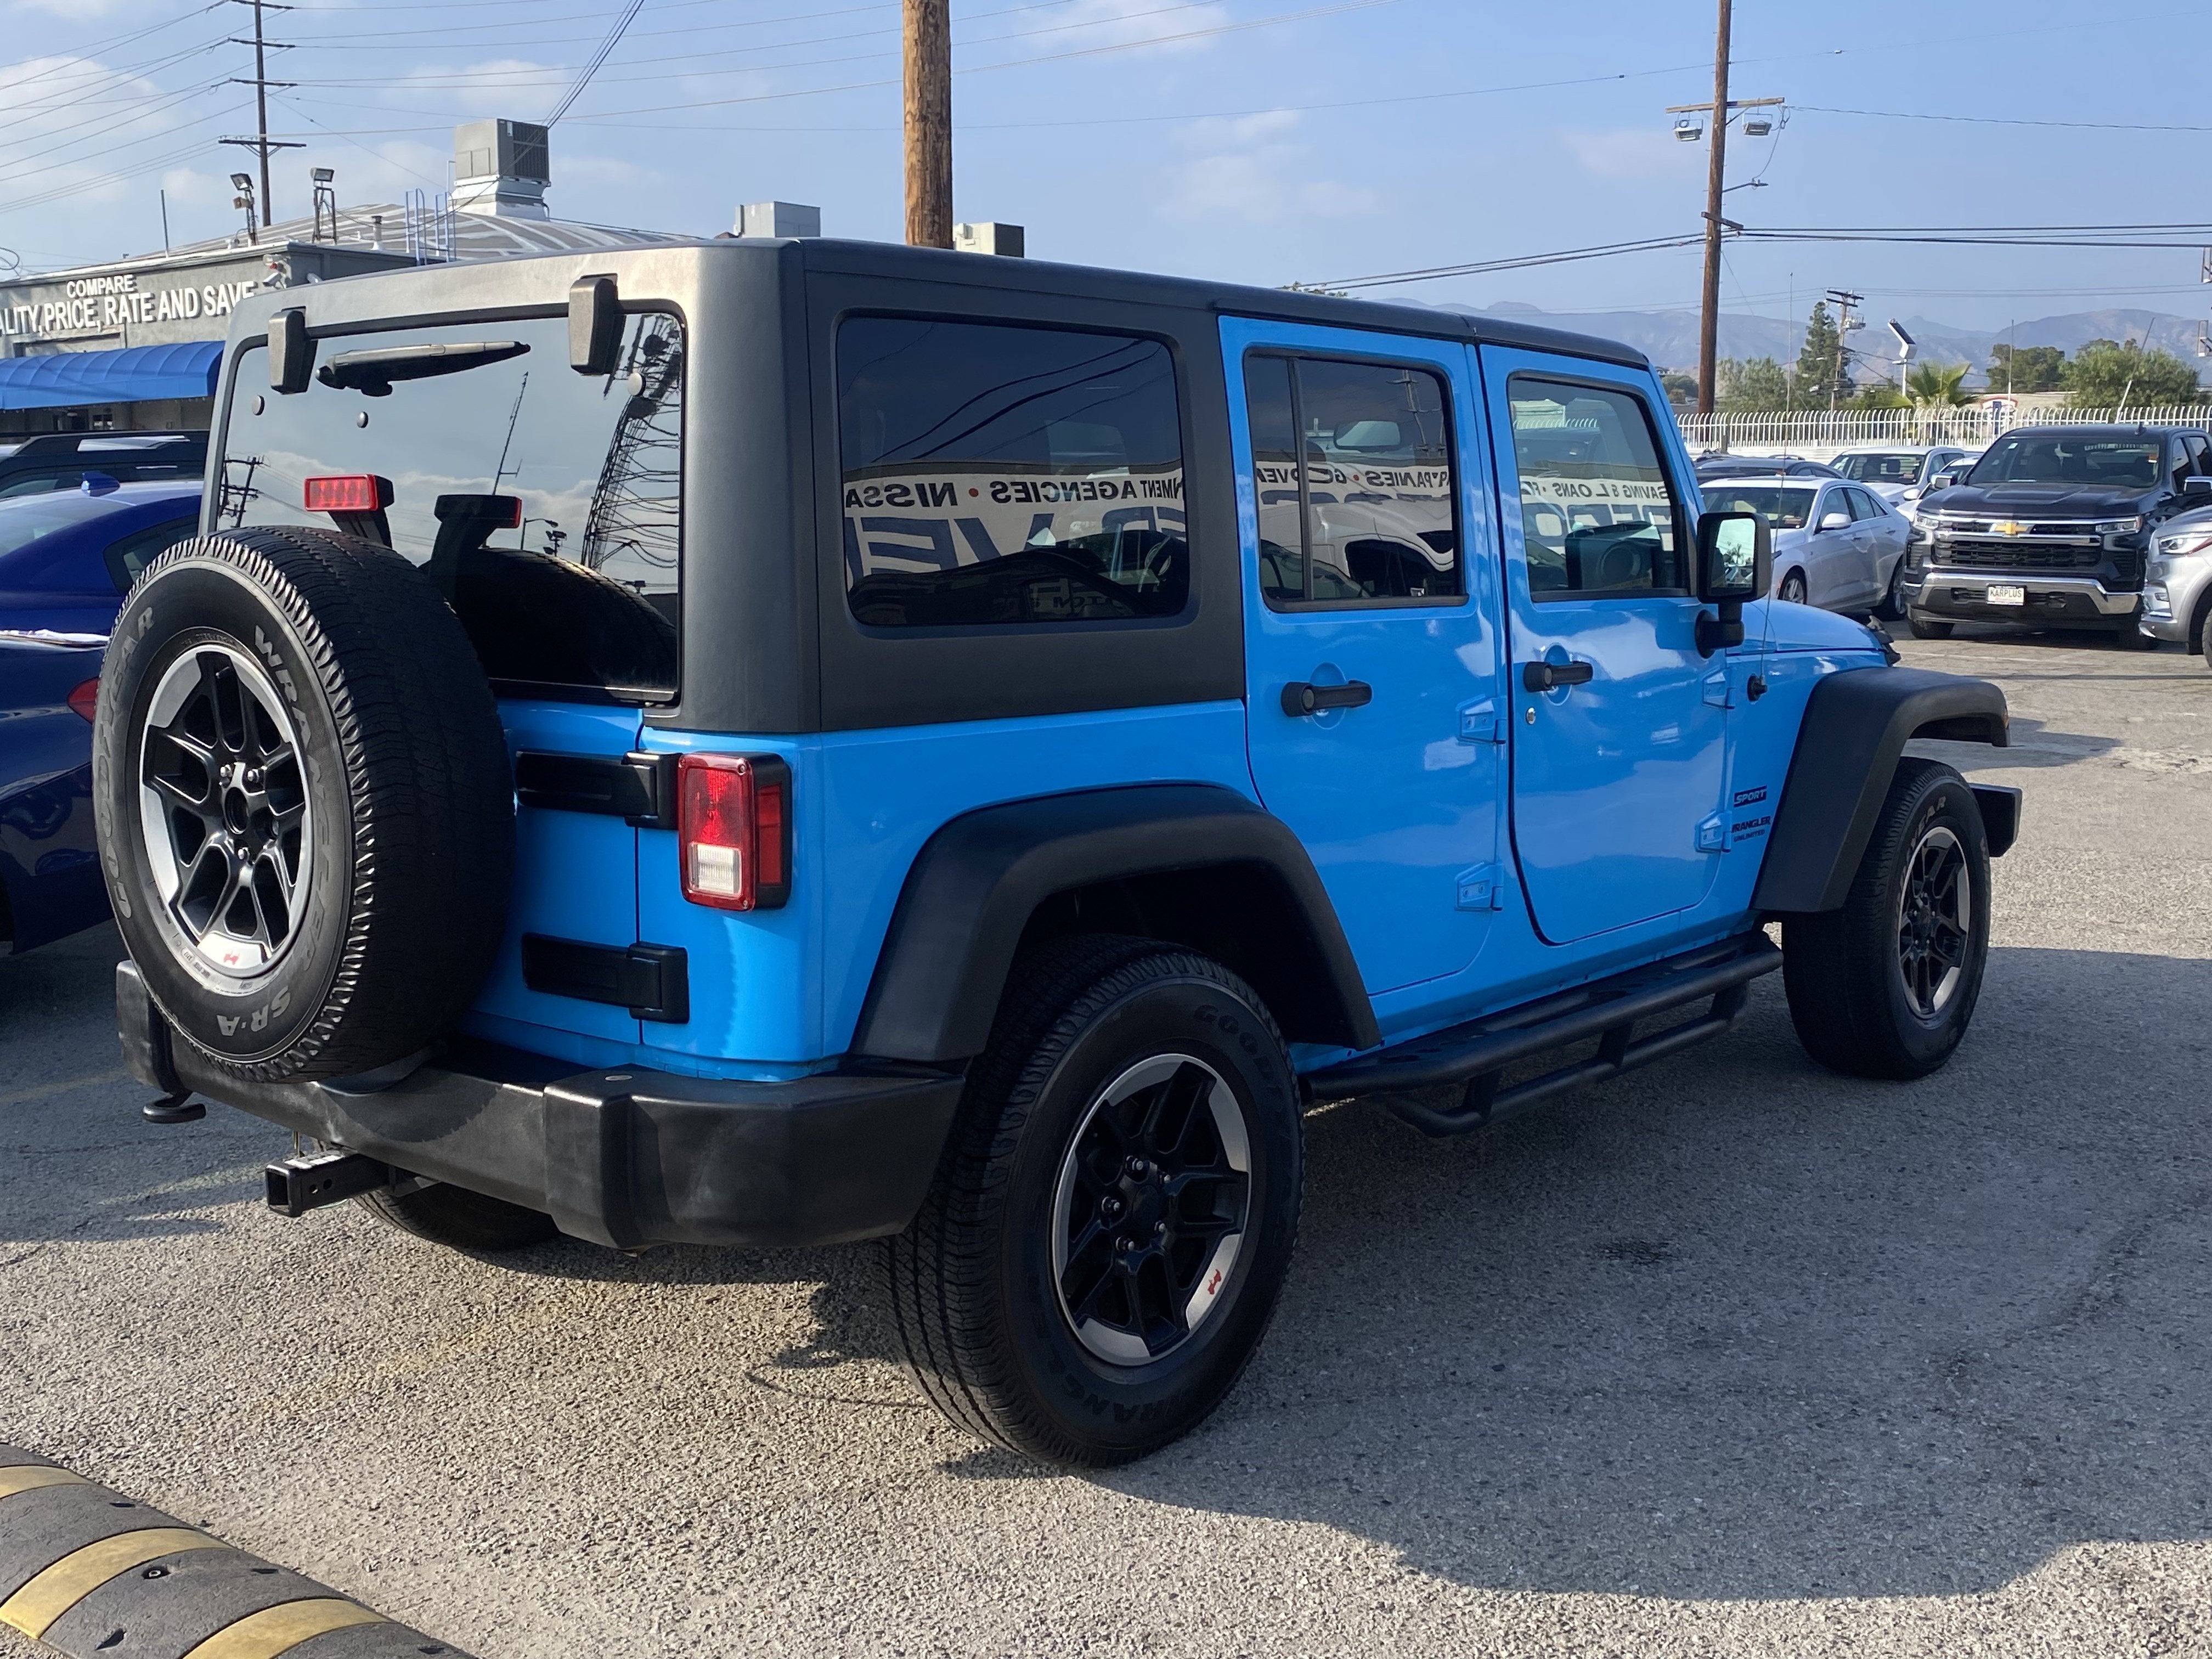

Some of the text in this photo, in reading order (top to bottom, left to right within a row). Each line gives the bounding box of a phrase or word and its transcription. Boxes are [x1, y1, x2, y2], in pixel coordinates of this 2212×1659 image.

[66, 274, 136, 298] COMPARE
[44, 298, 101, 332] PRICE,
[104, 292, 154, 325] RATE
[158, 287, 199, 320] AND
[203, 281, 255, 316] SAVE
[1990, 589, 2022, 598] KARPLUS
[96, 606, 154, 919] GOODYEAR
[255, 624, 329, 971] WRANGLER
[1735, 789, 1767, 805] SPORT
